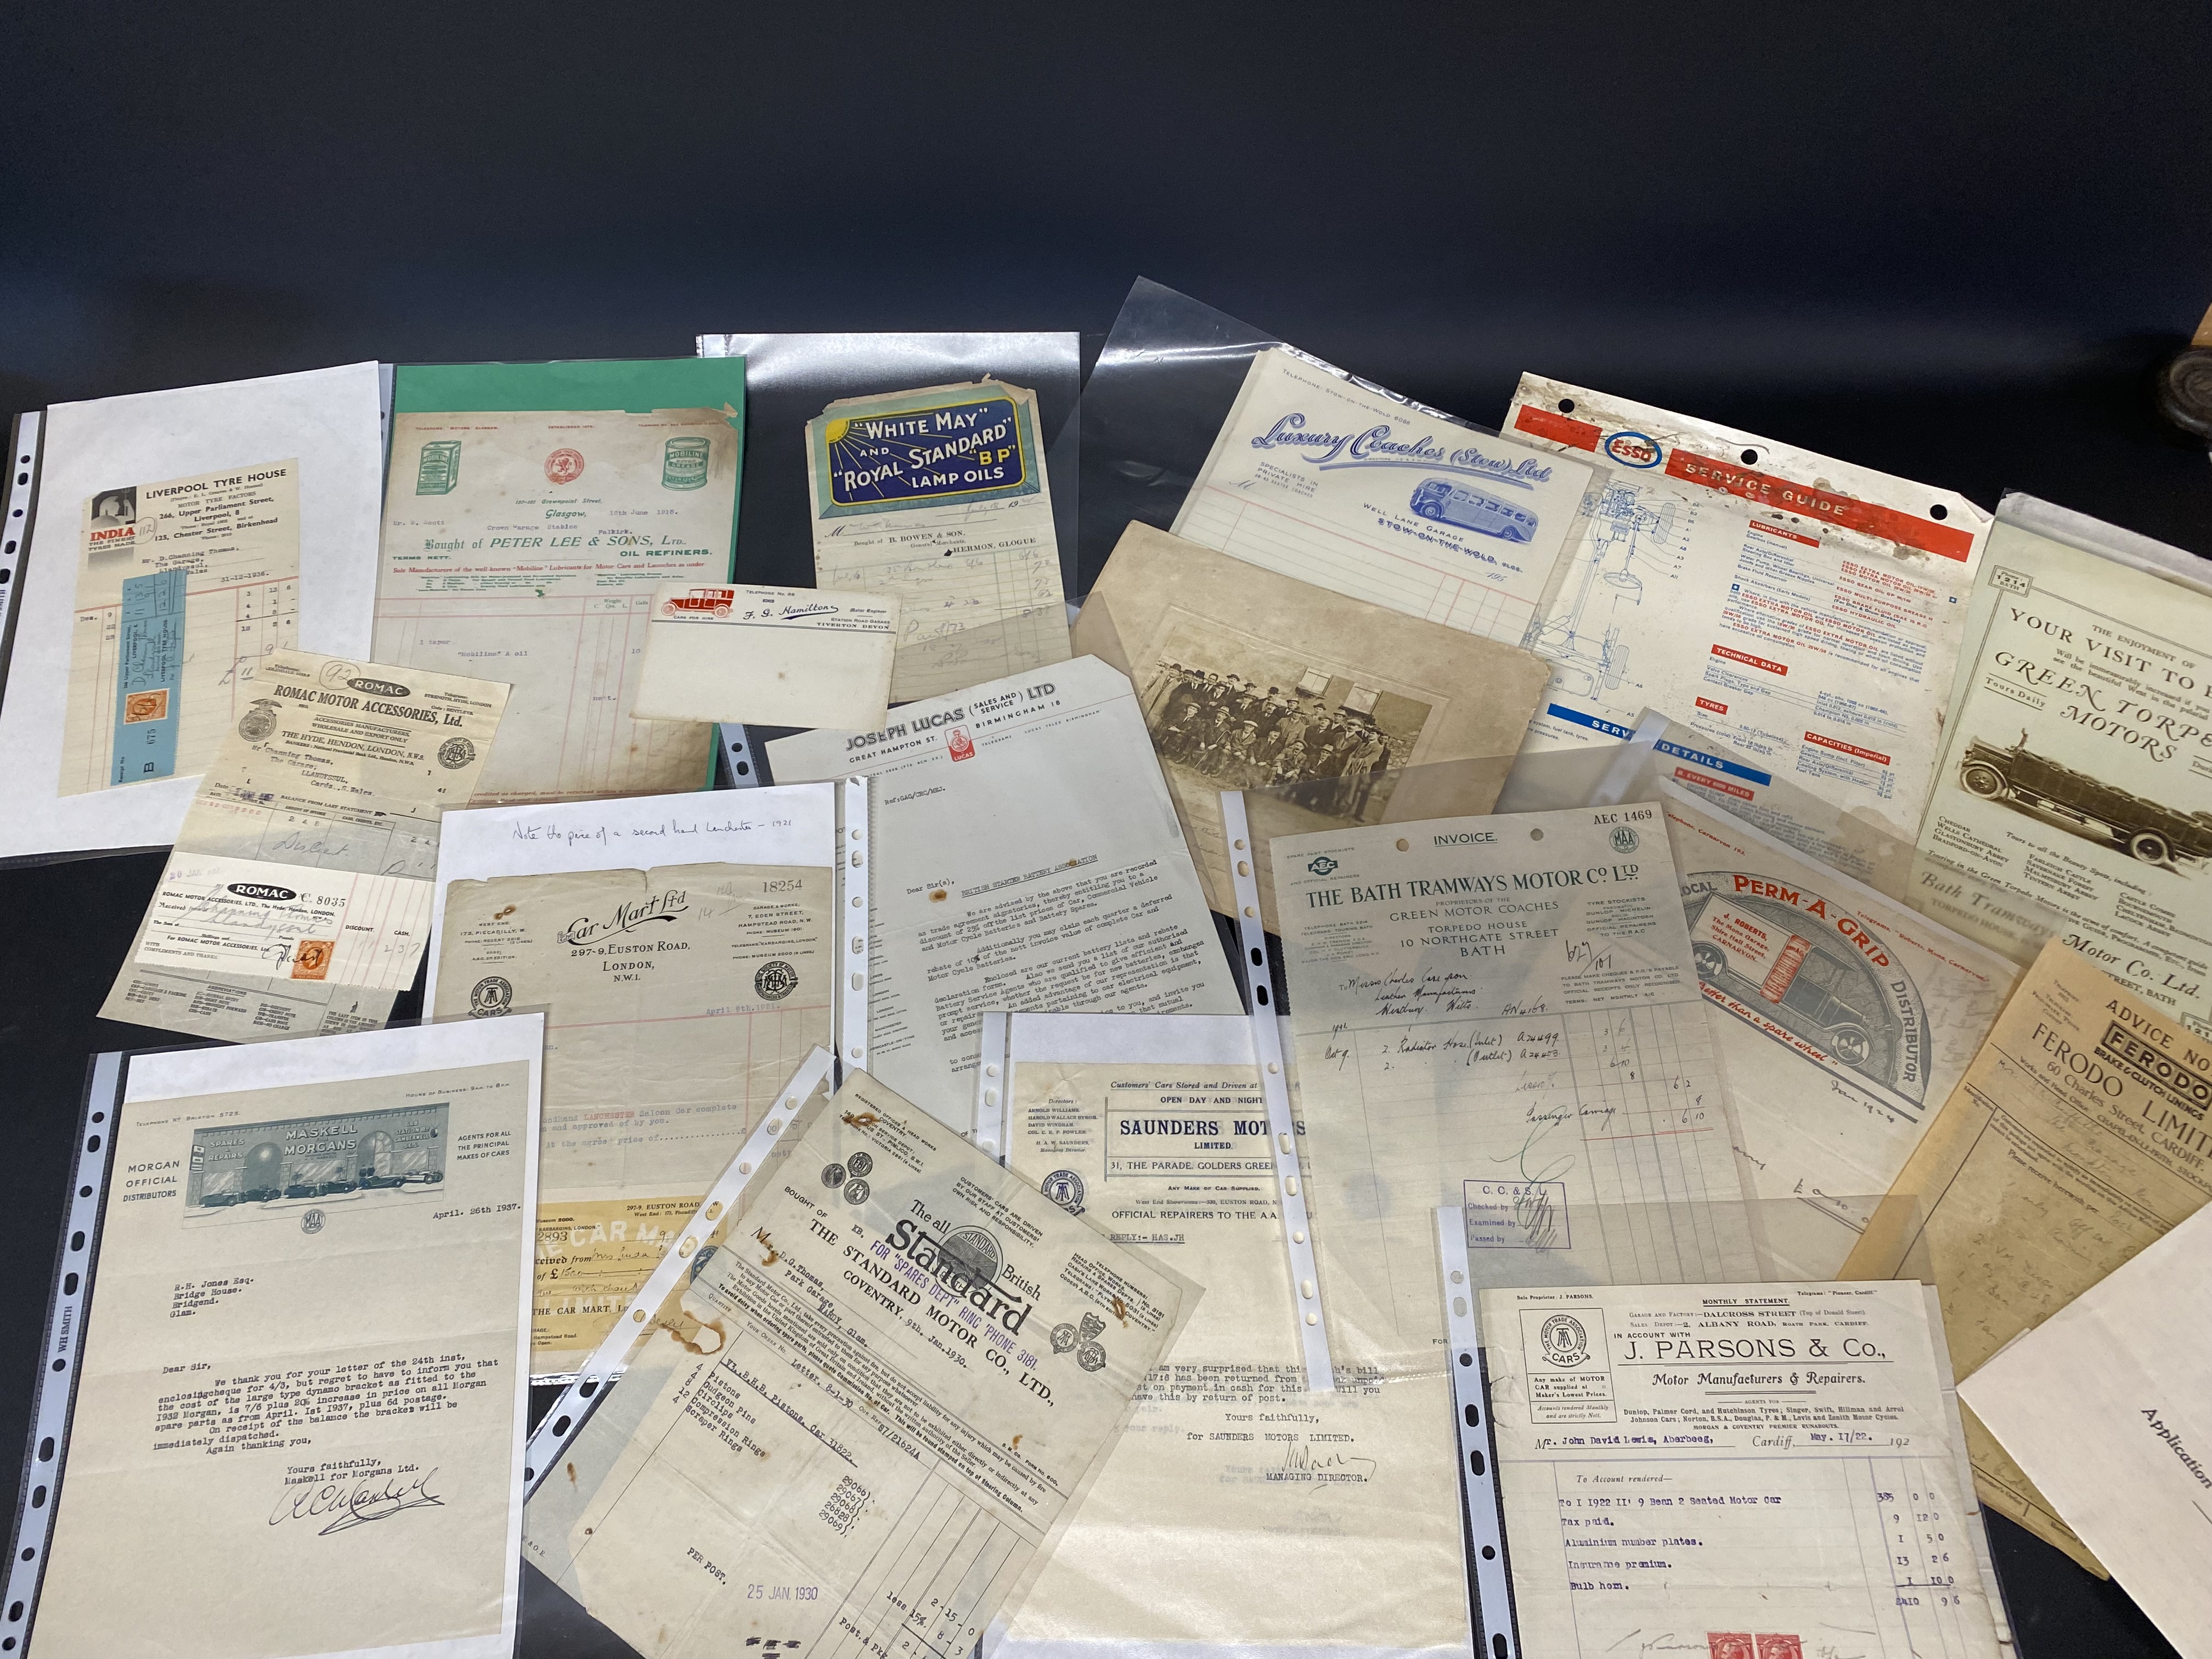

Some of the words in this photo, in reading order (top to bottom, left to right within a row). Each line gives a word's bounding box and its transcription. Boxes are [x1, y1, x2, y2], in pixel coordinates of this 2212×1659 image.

[859, 447, 891, 456] AND
[1251, 413, 1355, 463] Luxury
[1350, 424, 1445, 459] Coaches
[1450, 447, 1513, 471] (Stow)
[1509, 457, 1553, 483] Ltd
[1611, 438, 1651, 460] ESSO
[146, 482, 208, 499] LIVERPOOL
[213, 476, 242, 487] TYRE
[248, 469, 286, 482] HOUSE
[912, 473, 958, 488] LAMP
[964, 466, 1004, 482] OILS
[1685, 464, 1770, 494] SERVICE
[1782, 490, 1847, 515] GUIDE
[205, 501, 245, 512] Parliament
[545, 509, 586, 518] Glasgow,
[194, 511, 231, 522] Liverpool,
[236, 517, 278, 528] Birkenhead
[1364, 503, 1386, 516] WELL
[1395, 514, 1419, 526] LANE
[1426, 526, 1464, 541] GARAGE
[91, 527, 134, 541] INDIA
[900, 533, 932, 541] BOWEN
[1752, 522, 1797, 539] LUBRICANTS
[425, 538, 464, 550] Bought
[472, 538, 483, 549] of
[489, 537, 543, 548] PETER
[550, 537, 582, 546] LEE
[588, 537, 600, 546] &
[606, 535, 653, 546] SONS,
[953, 543, 995, 552] HERMON,
[998, 537, 1036, 547] GLOGUE
[1378, 518, 1497, 565] STOW-ON-THE-WOLD,
[2011, 607, 2072, 643] YOUR
[2085, 637, 2151, 673] VISIT
[2162, 667, 2195, 690] TO
[1717, 647, 1757, 664] TECHNICAL
[1760, 661, 1781, 672] DATA
[354, 680, 403, 695] ROMAC
[1995, 652, 2102, 708] GREEN
[1026, 684, 1055, 699] LTD
[1985, 676, 2014, 693] Tours
[2017, 691, 2045, 707] Daily
[273, 685, 317, 701] ROMAC
[317, 692, 359, 709] MOTOR
[360, 700, 438, 725] ACCESSORIES,
[443, 713, 462, 727] Ltd.
[1700, 699, 1723, 710] TYRES
[912, 707, 964, 733] LUCAS
[975, 704, 1045, 729] BIRMINGHAM
[2059, 705, 2177, 762] MOTORS
[849, 752, 876, 763] GREAT
[881, 740, 921, 754] HAMPTON
[1662, 743, 1723, 769] DETAILS
[1803, 731, 1852, 751] CAPACITIES
[1854, 748, 1886, 762] (Imperial)
[1594, 814, 1617, 825] AEC
[1625, 809, 1652, 821] 1469
[1434, 832, 1497, 845] INVOICE.
[235, 884, 288, 898] ROMAC
[763, 879, 803, 893] 18254
[1305, 889, 1344, 908] THE
[1350, 883, 1402, 903] BATH
[1406, 875, 1507, 896] TRAMWAYS
[1511, 870, 1583, 890] MOTOR
[317, 896, 346, 907] 8035
[1390, 909, 1438, 921] GREEN
[1444, 906, 1492, 917] MOTOR
[1498, 901, 1558, 913] COACHES
[1427, 923, 1481, 933] TORPEDO
[1488, 921, 1527, 929] HOUSE
[1733, 874, 1889, 968] PERM-A-GRIP
[1734, 918, 1767, 941] ROBERTS,
[1401, 939, 1413, 947] 10
[1419, 933, 1502, 945] NORTHGATE
[1509, 928, 1558, 940] STREET
[608, 944, 653, 955] EUSTON
[657, 941, 690, 951] ROAD,
[1460, 945, 1505, 957] BATH
[602, 961, 654, 971] LONDON,
[2062, 934, 2121, 963] Motor
[2126, 960, 2153, 980] Co.
[2161, 973, 2199, 998] Ltd.
[1891, 980, 1918, 1082] DISTRIBUTOR
[2105, 999, 2174, 1048] ADVICE
[2032, 1022, 2123, 1096] FERODO
[2109, 1031, 2209, 1099] FERODO
[286, 1125, 357, 1139] MASKELL
[1120, 1120, 1218, 1135] SAUNDERS
[285, 1139, 357, 1157] MORGANS
[128, 1160, 179, 1173] MORGAN
[126, 1175, 177, 1187] OFFICIAL
[122, 1189, 176, 1201] DISTRIBUTORS
[432, 1209, 463, 1219] April.
[470, 1206, 491, 1215] 26th
[910, 1199, 931, 1222] The
[932, 1220, 951, 1237] all
[885, 1219, 1032, 1336] Standard
[1001, 1264, 1040, 1301] British
[843, 1270, 904, 1319] COVENTRY,
[61, 1306, 72, 1334] SMITH
[809, 1218, 838, 1245] THE
[843, 1245, 920, 1305] STANDARD
[925, 1304, 977, 1348] MOTOR
[985, 1349, 1009, 1375] CO.,
[1018, 1372, 1054, 1407] LTD.,
[58, 1336, 68, 1352] WH
[1624, 1341, 1643, 1359] J.
[1655, 1339, 1795, 1358] PARSONS
[1809, 1339, 1829, 1357] &
[1843, 1338, 1885, 1359] Co.,
[1652, 1373, 1689, 1385] Motor
[1697, 1372, 1782, 1386] Manufacturers
[1790, 1372, 1799, 1385] &
[1806, 1372, 1865, 1385] Repairers.
[1752, 1435, 1799, 1449] Cardiff,
[2141, 1408, 2212, 1489] Application
[1266, 1472, 1312, 1481] MANAGING
[1317, 1473, 1367, 1482] DIRECTOR.
[747, 1584, 763, 1599] 25
[795, 1587, 818, 1600] 1930
